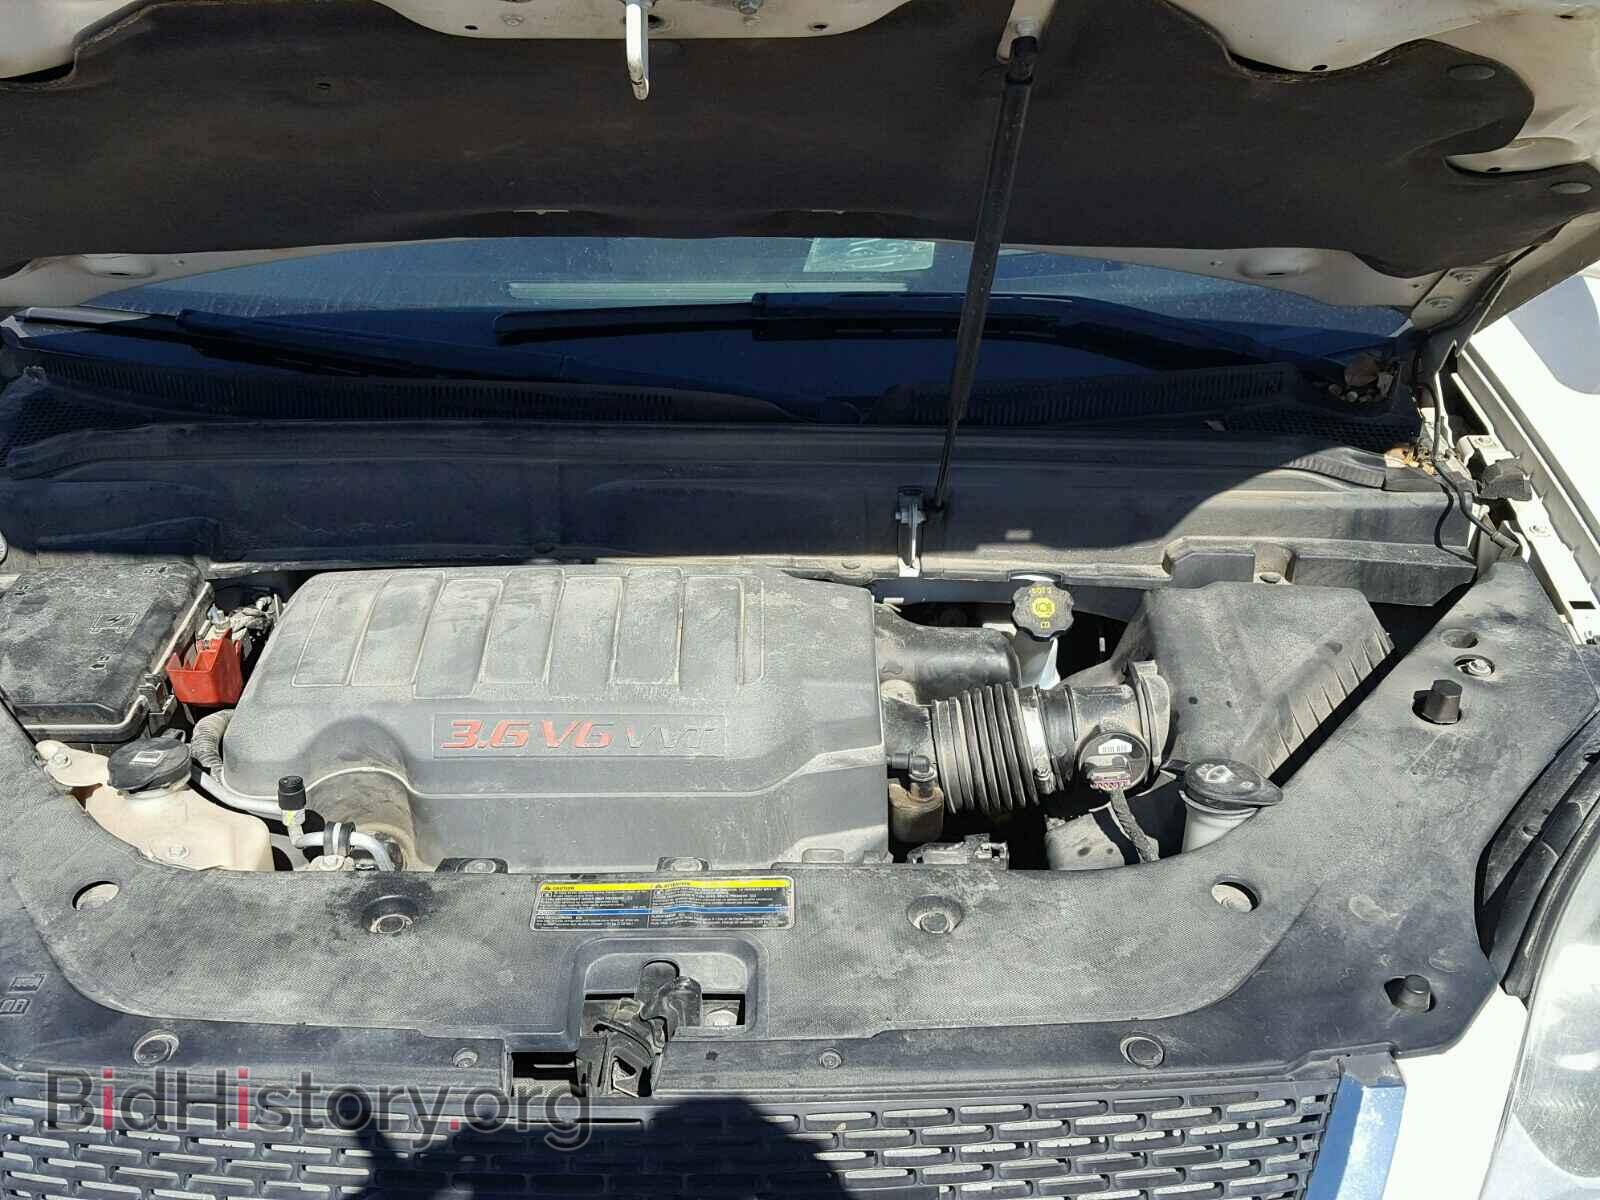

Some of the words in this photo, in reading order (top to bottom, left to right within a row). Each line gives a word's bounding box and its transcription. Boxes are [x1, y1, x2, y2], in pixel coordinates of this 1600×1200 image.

[440, 719, 530, 749] 3.6
[540, 719, 615, 749] V6
[626, 726, 717, 749] VVT
